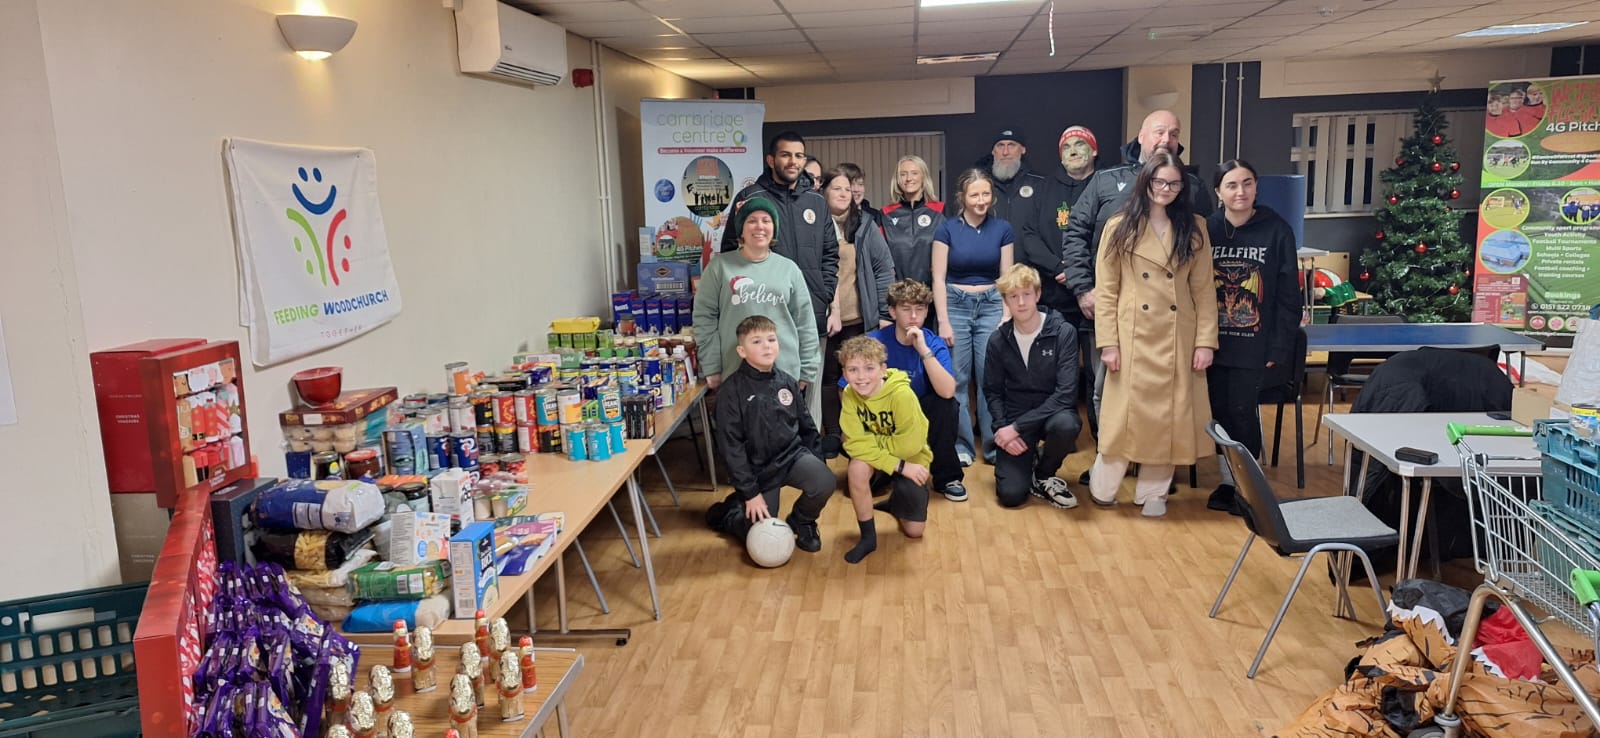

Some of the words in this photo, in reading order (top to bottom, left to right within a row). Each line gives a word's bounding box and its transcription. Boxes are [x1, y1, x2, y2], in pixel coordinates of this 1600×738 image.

[1546, 122, 1566, 132] 4G
[672, 131, 727, 143] centre
[1211, 246, 1267, 264] ELLFIRE
[273, 303, 319, 325] FEEDING
[323, 289, 390, 316] WOODCHURCH
